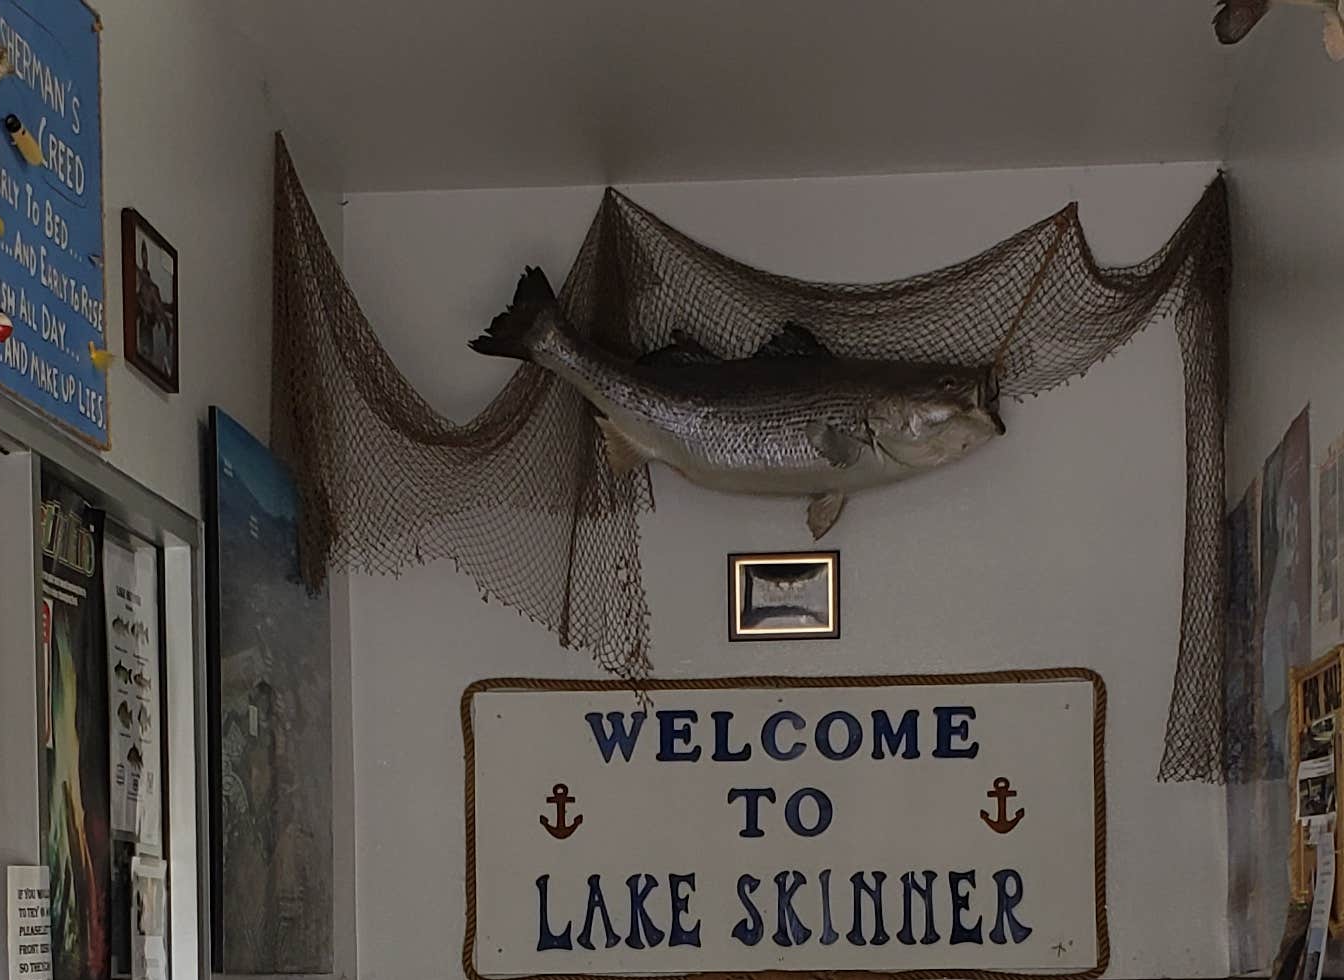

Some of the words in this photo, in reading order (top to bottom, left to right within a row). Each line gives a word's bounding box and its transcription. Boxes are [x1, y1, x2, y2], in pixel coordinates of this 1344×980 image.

[38, 117, 85, 195] CREED
[40, 246, 68, 305] EARLY
[19, 288, 37, 332] ALL
[31, 353, 58, 399] MAKE
[61, 372, 75, 402] UP
[583, 705, 981, 764] WELCOME
[727, 787, 833, 838] TO
[535, 871, 702, 953] LAKE
[730, 868, 1033, 948] SKINNER
